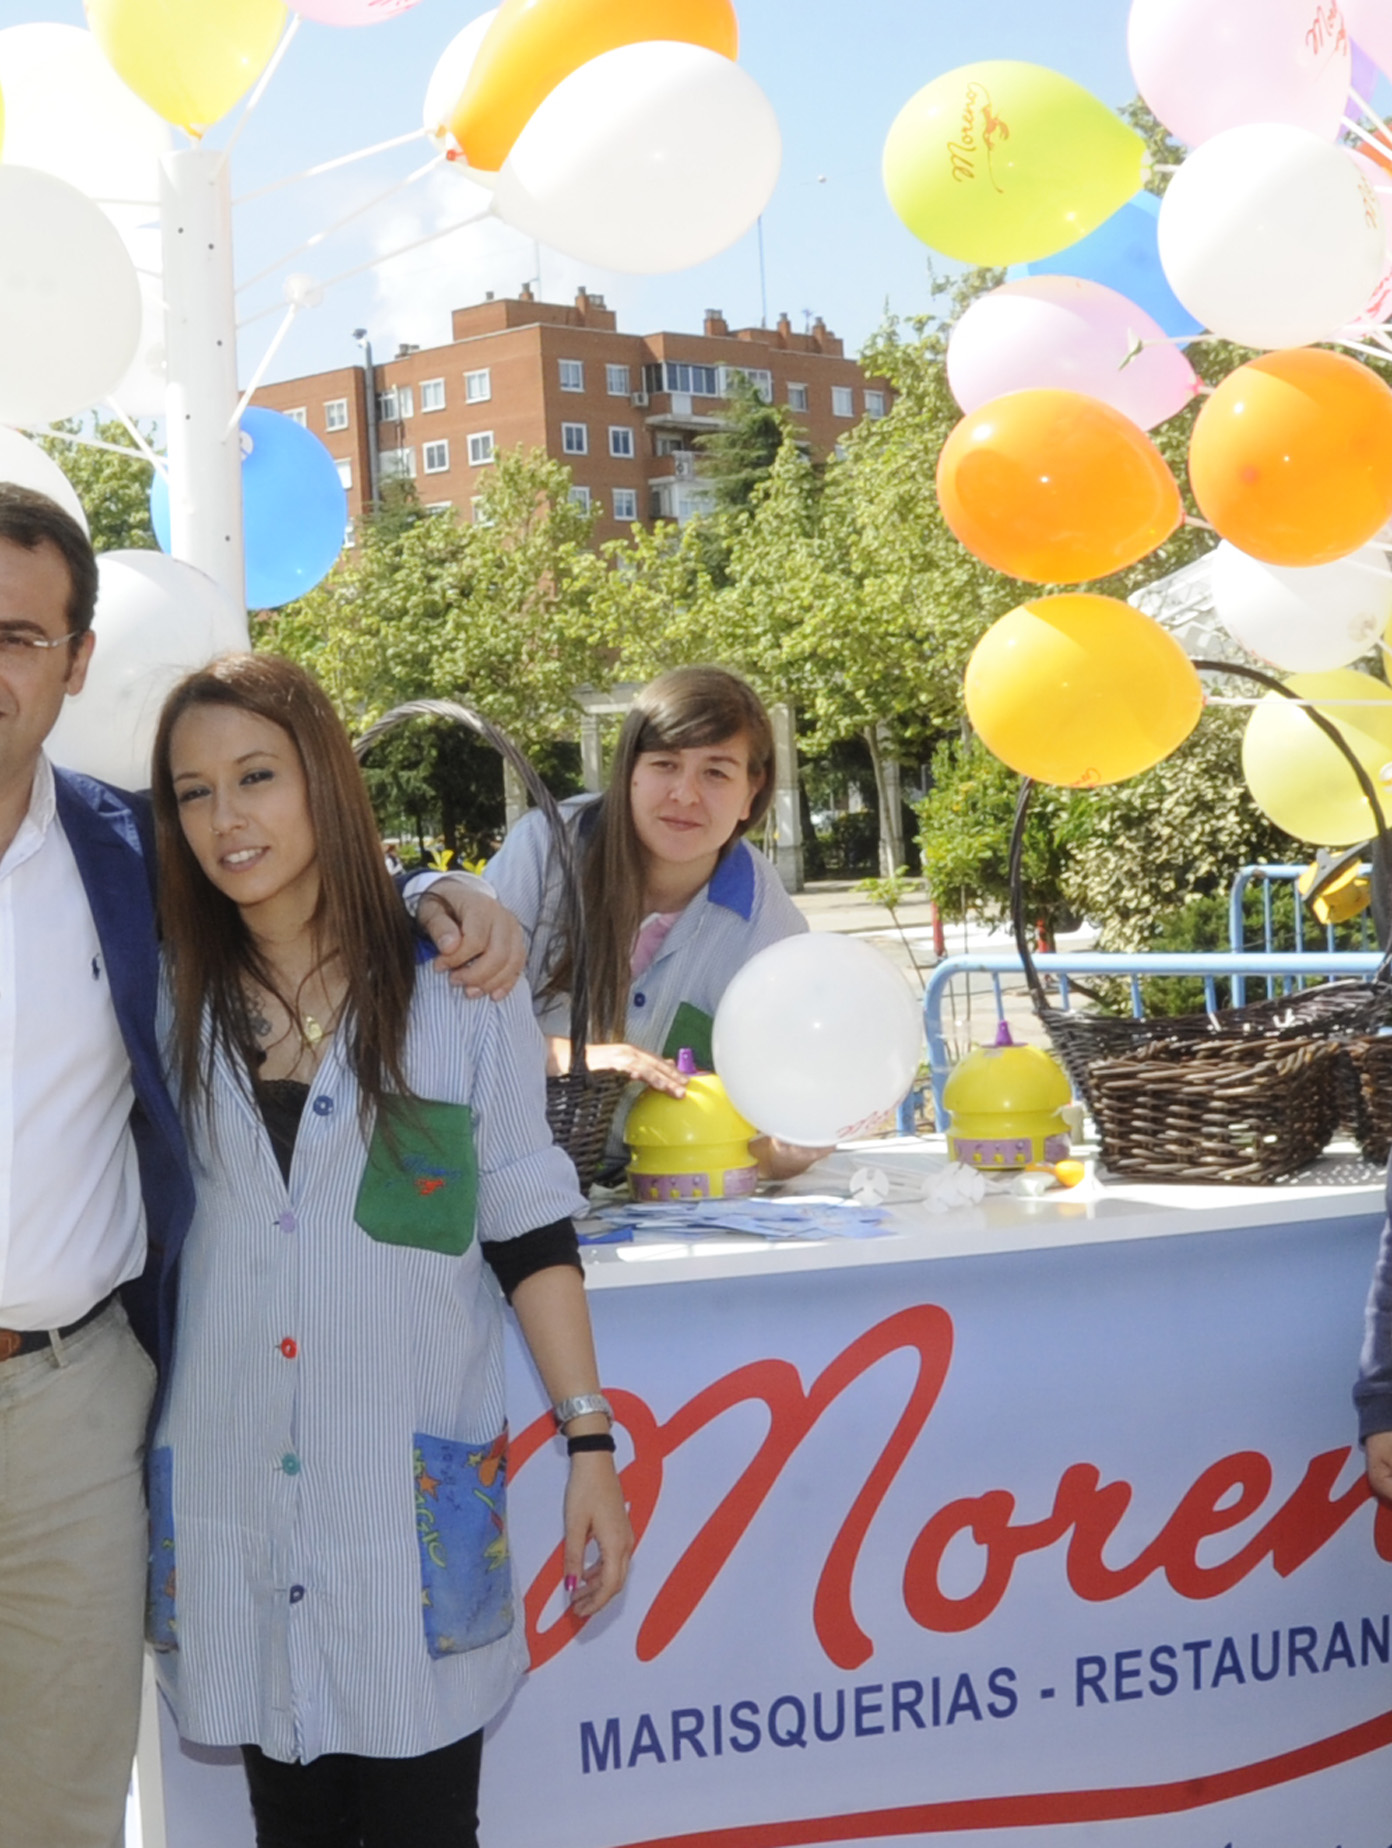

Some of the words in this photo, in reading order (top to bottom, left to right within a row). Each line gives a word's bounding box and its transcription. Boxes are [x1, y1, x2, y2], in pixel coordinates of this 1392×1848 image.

[947, 81, 987, 183] Moreno
[579, 1666, 1019, 1775] MARISQUERIAS
[1075, 1613, 1390, 1708] RESTAURAN
